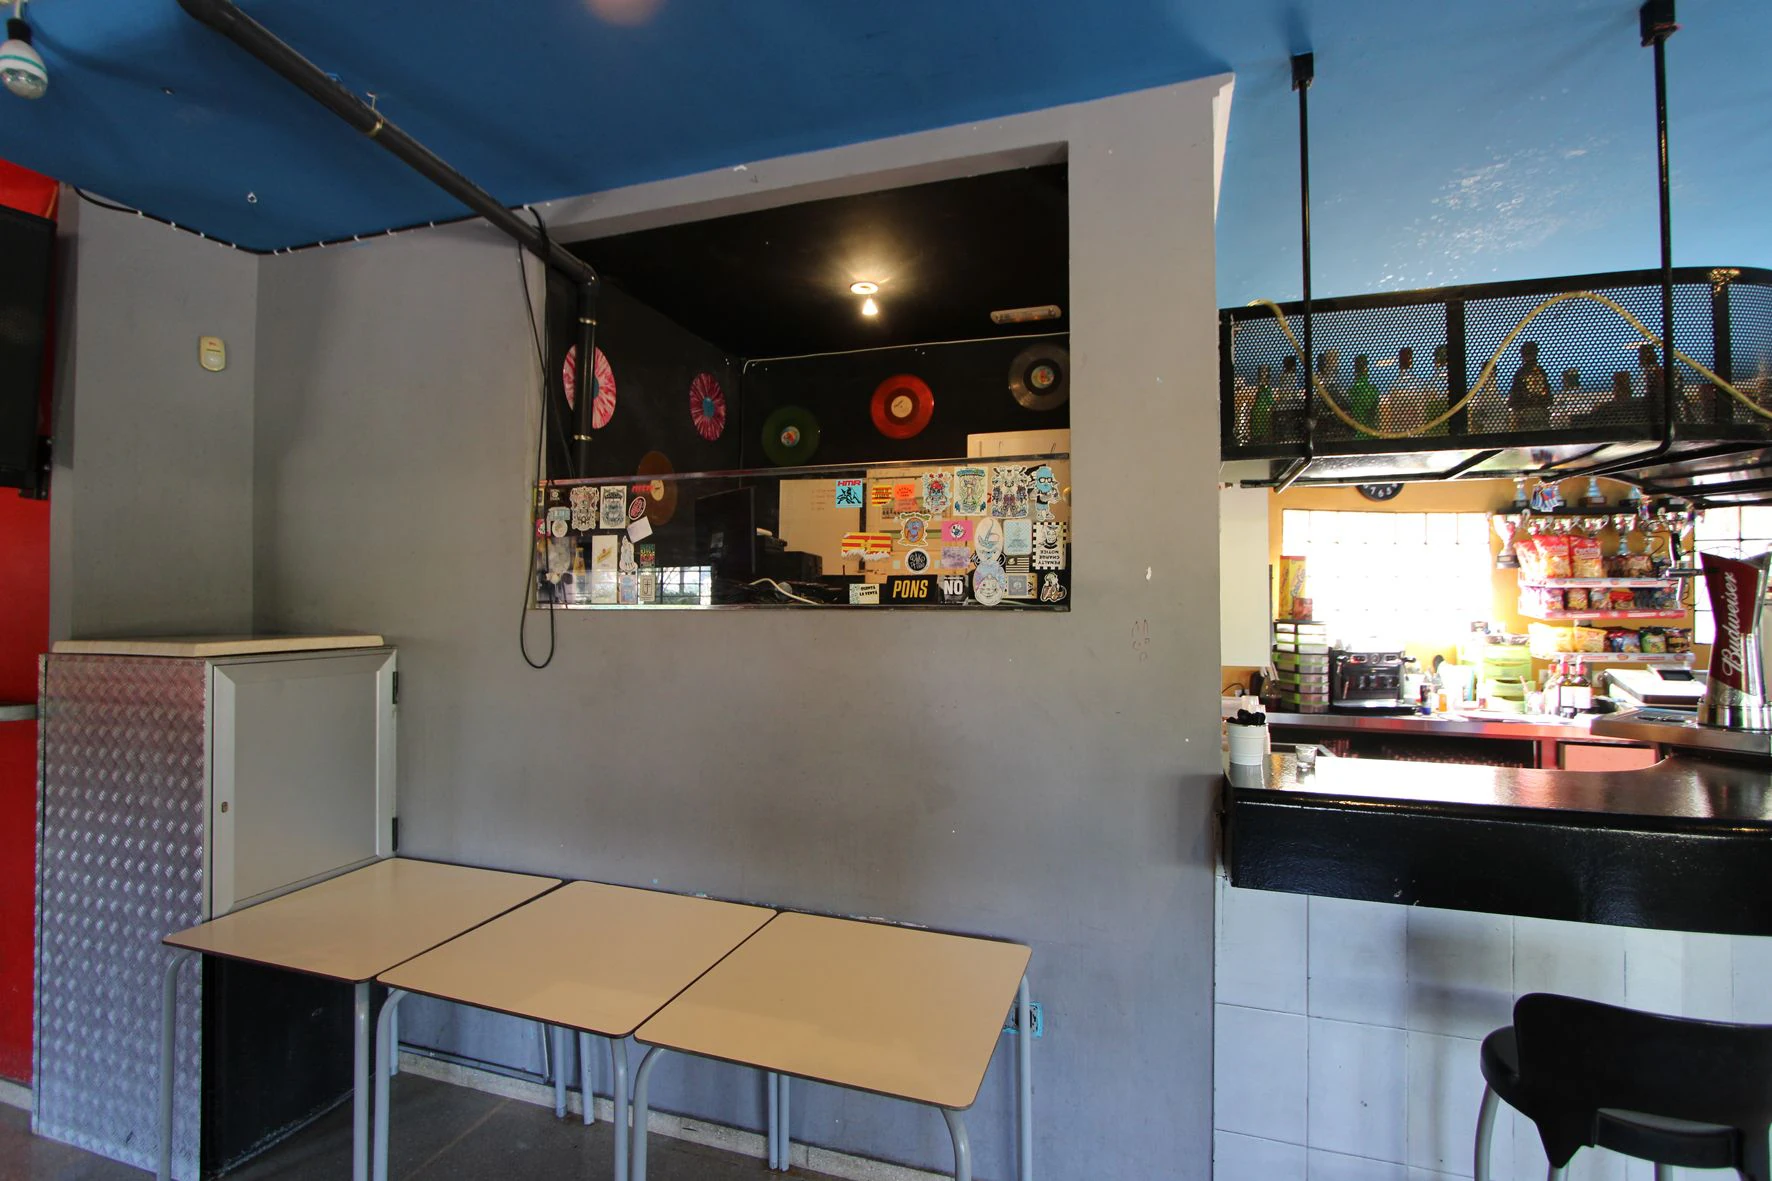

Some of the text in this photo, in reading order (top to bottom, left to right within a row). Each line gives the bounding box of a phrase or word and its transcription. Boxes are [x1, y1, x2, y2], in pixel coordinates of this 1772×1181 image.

[1370, 486, 1377, 495] 7
[1378, 489, 1384, 498] 6
[1386, 487, 1392, 495] 5
[893, 580, 928, 598] PONS
[943, 580, 963, 595] NO
[1721, 571, 1743, 676] Budweiser
